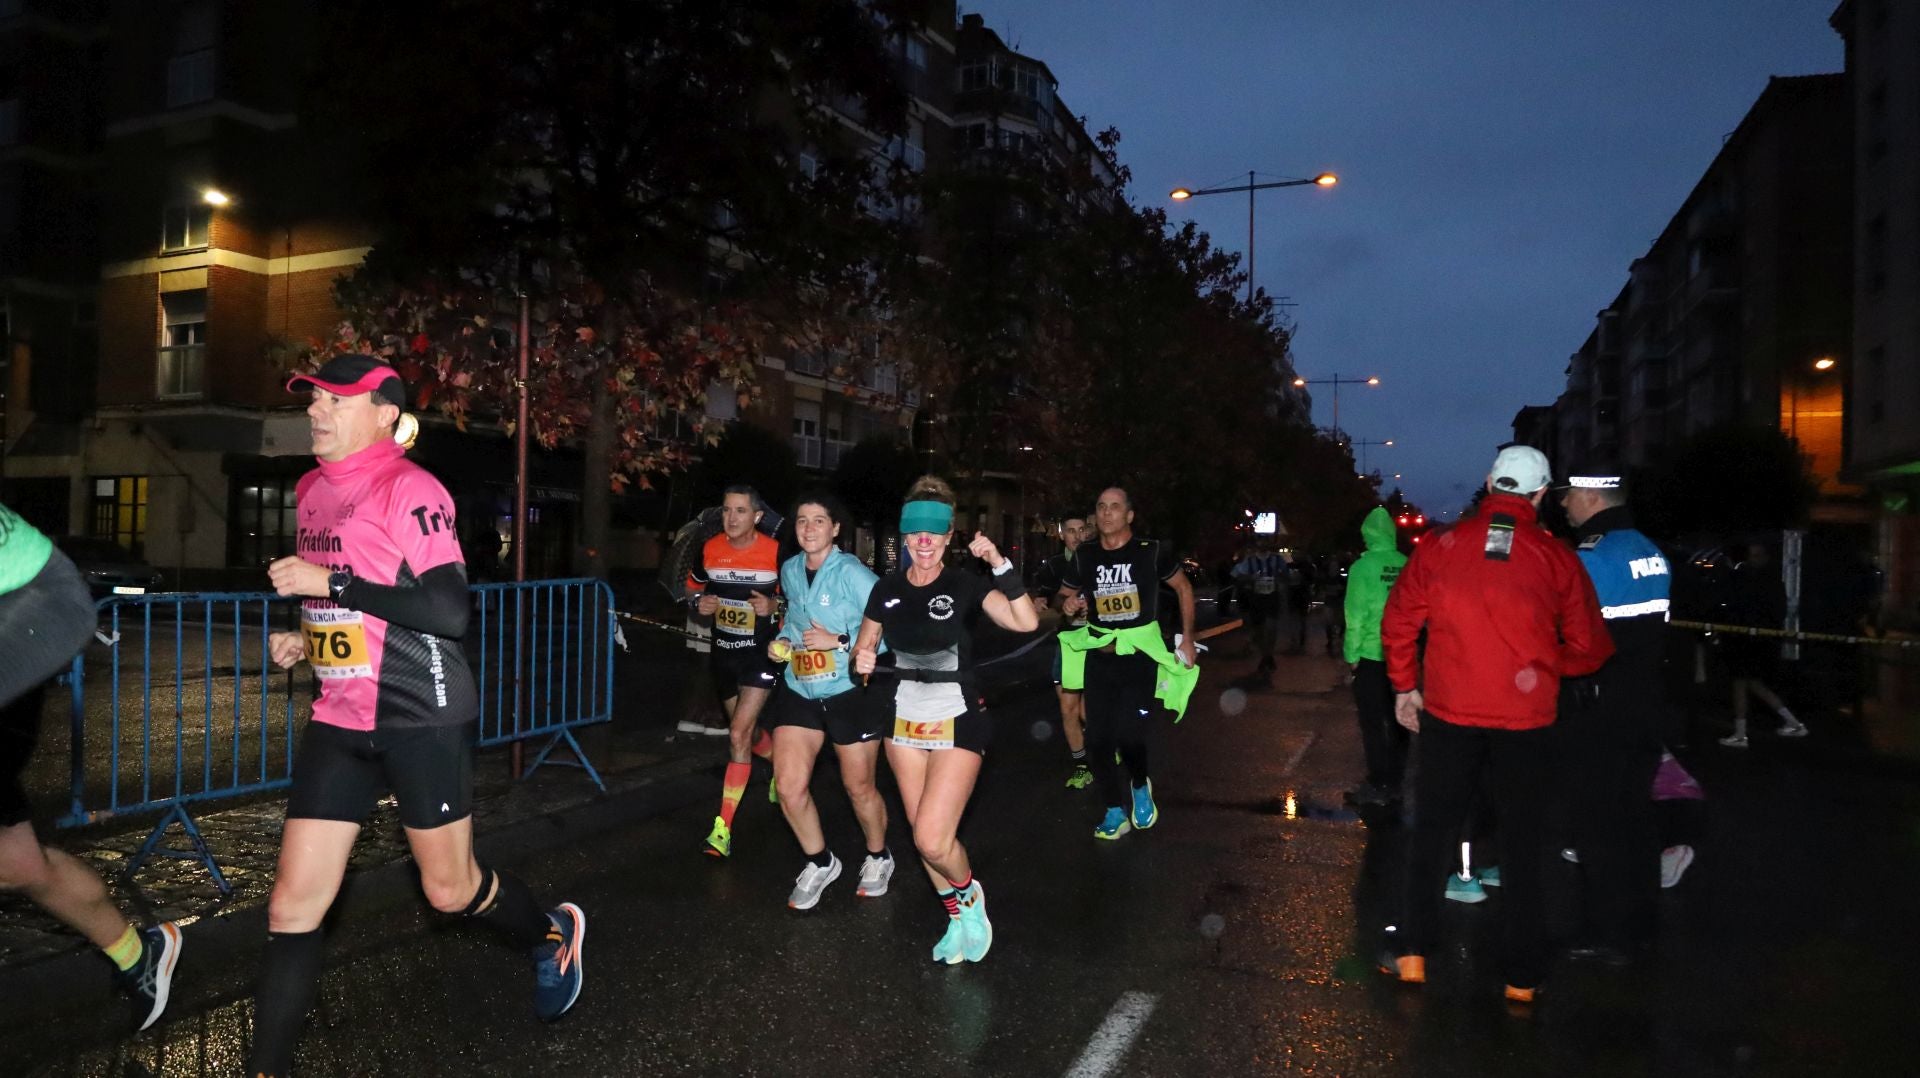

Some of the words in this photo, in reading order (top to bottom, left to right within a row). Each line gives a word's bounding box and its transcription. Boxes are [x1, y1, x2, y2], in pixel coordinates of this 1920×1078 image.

[298, 526, 342, 552] Triatlón
[1096, 563, 1132, 584] 3x7K
[1102, 595, 1133, 612] 180
[718, 608, 748, 626] 492
[716, 638, 757, 649] CRISTOBAL
[794, 652, 827, 671] 790
